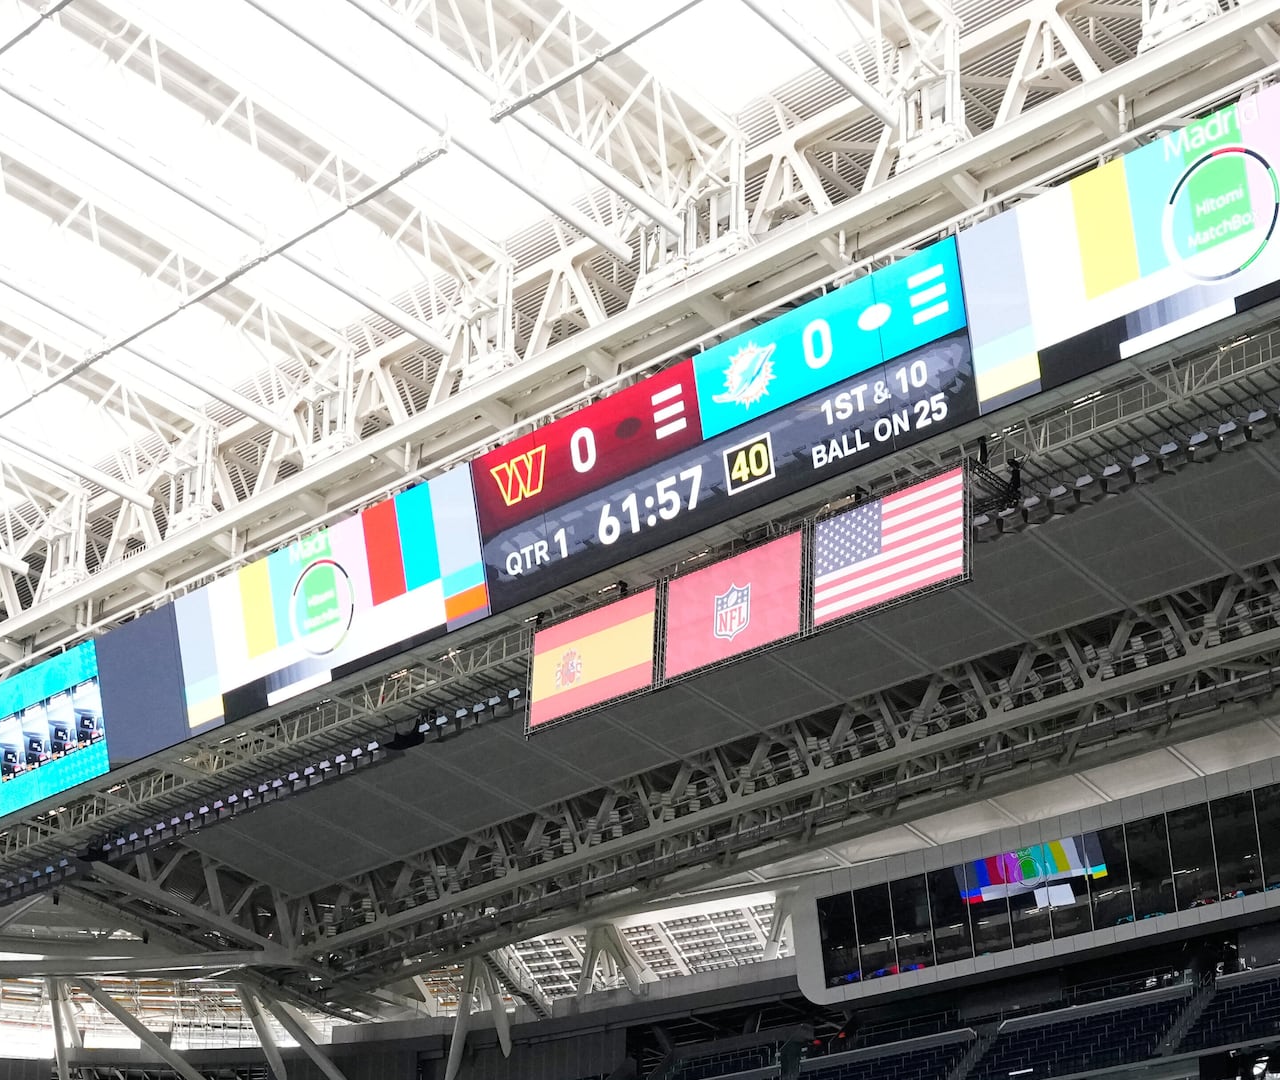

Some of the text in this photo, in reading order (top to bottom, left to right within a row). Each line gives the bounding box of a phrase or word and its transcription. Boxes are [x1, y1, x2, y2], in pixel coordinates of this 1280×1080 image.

[1195, 184, 1244, 217] Hitomi
[802, 319, 833, 369] 0
[821, 360, 928, 425] 1ST & 10
[570, 427, 597, 473] 0
[811, 392, 948, 469] BALL ON 25
[731, 442, 769, 482] 40
[506, 464, 703, 576] QTR 1 61:57
[718, 606, 745, 632] NFL
